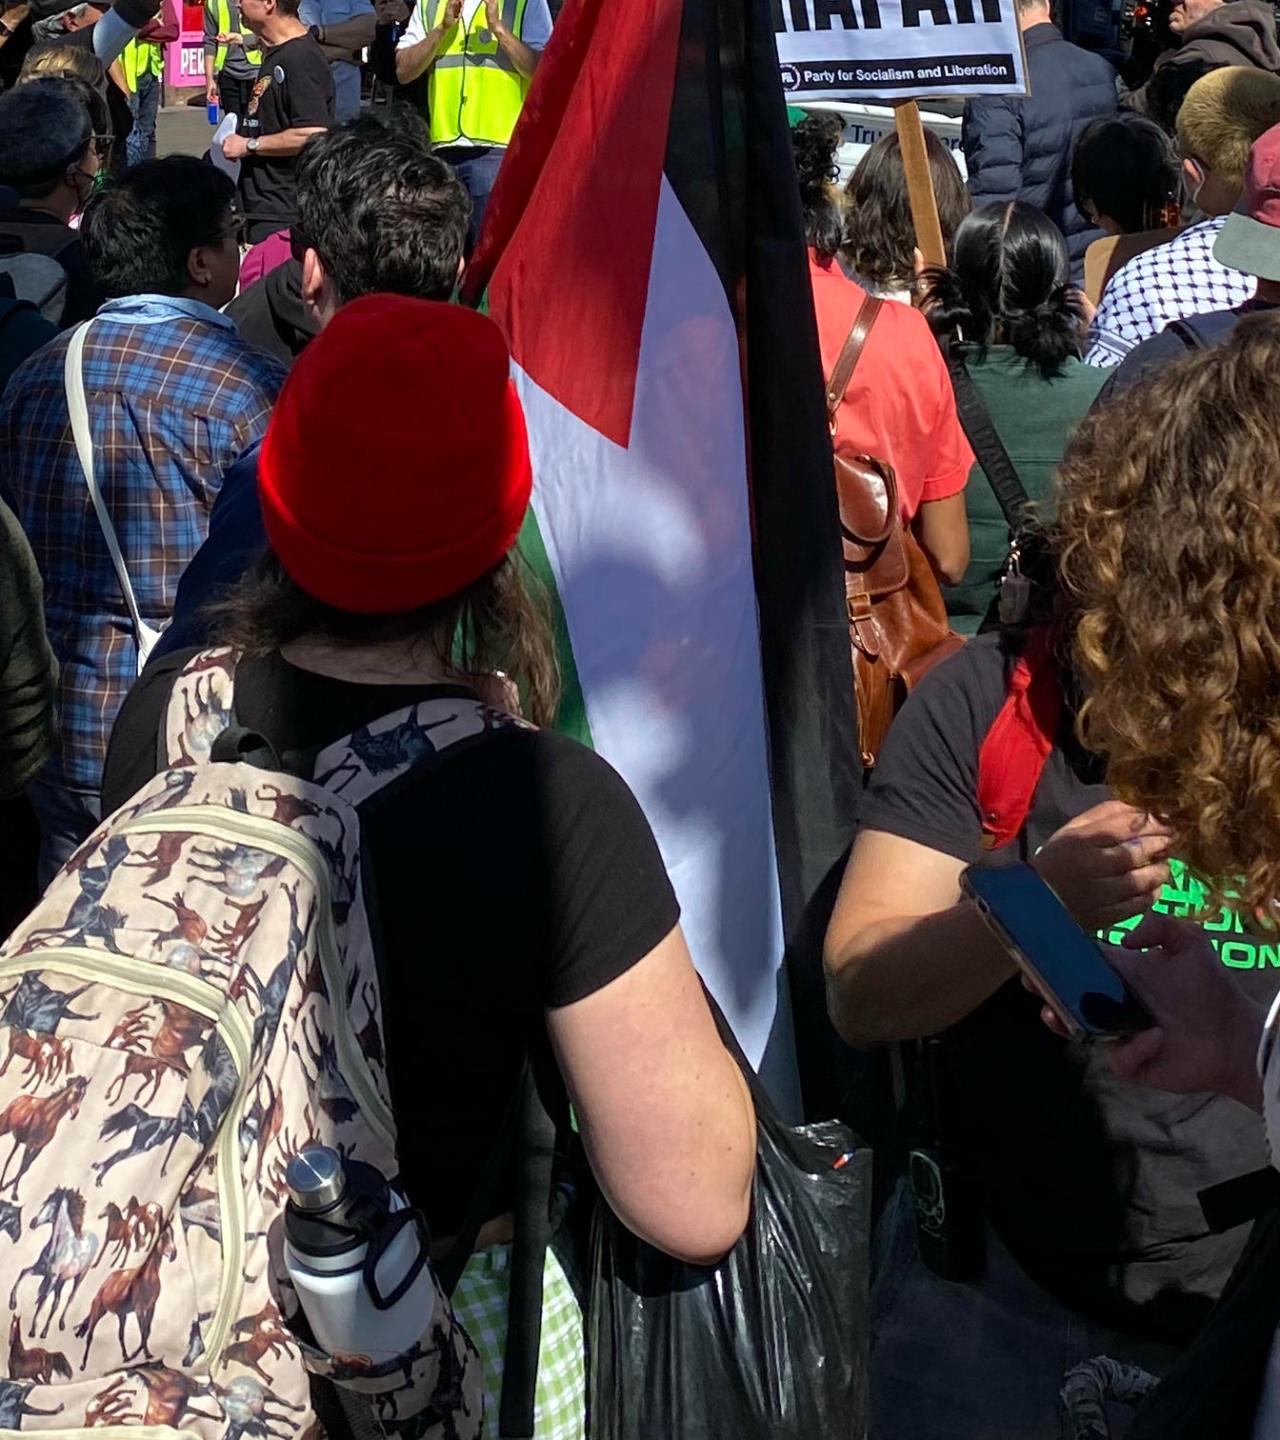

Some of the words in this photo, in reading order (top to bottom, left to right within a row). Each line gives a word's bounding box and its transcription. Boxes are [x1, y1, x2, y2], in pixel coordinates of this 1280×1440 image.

[804, 69, 835, 83] Party
[837, 68, 854, 81] for
[856, 67, 914, 81] Socialism
[917, 66, 942, 78] and
[945, 63, 1008, 77] Liberation
